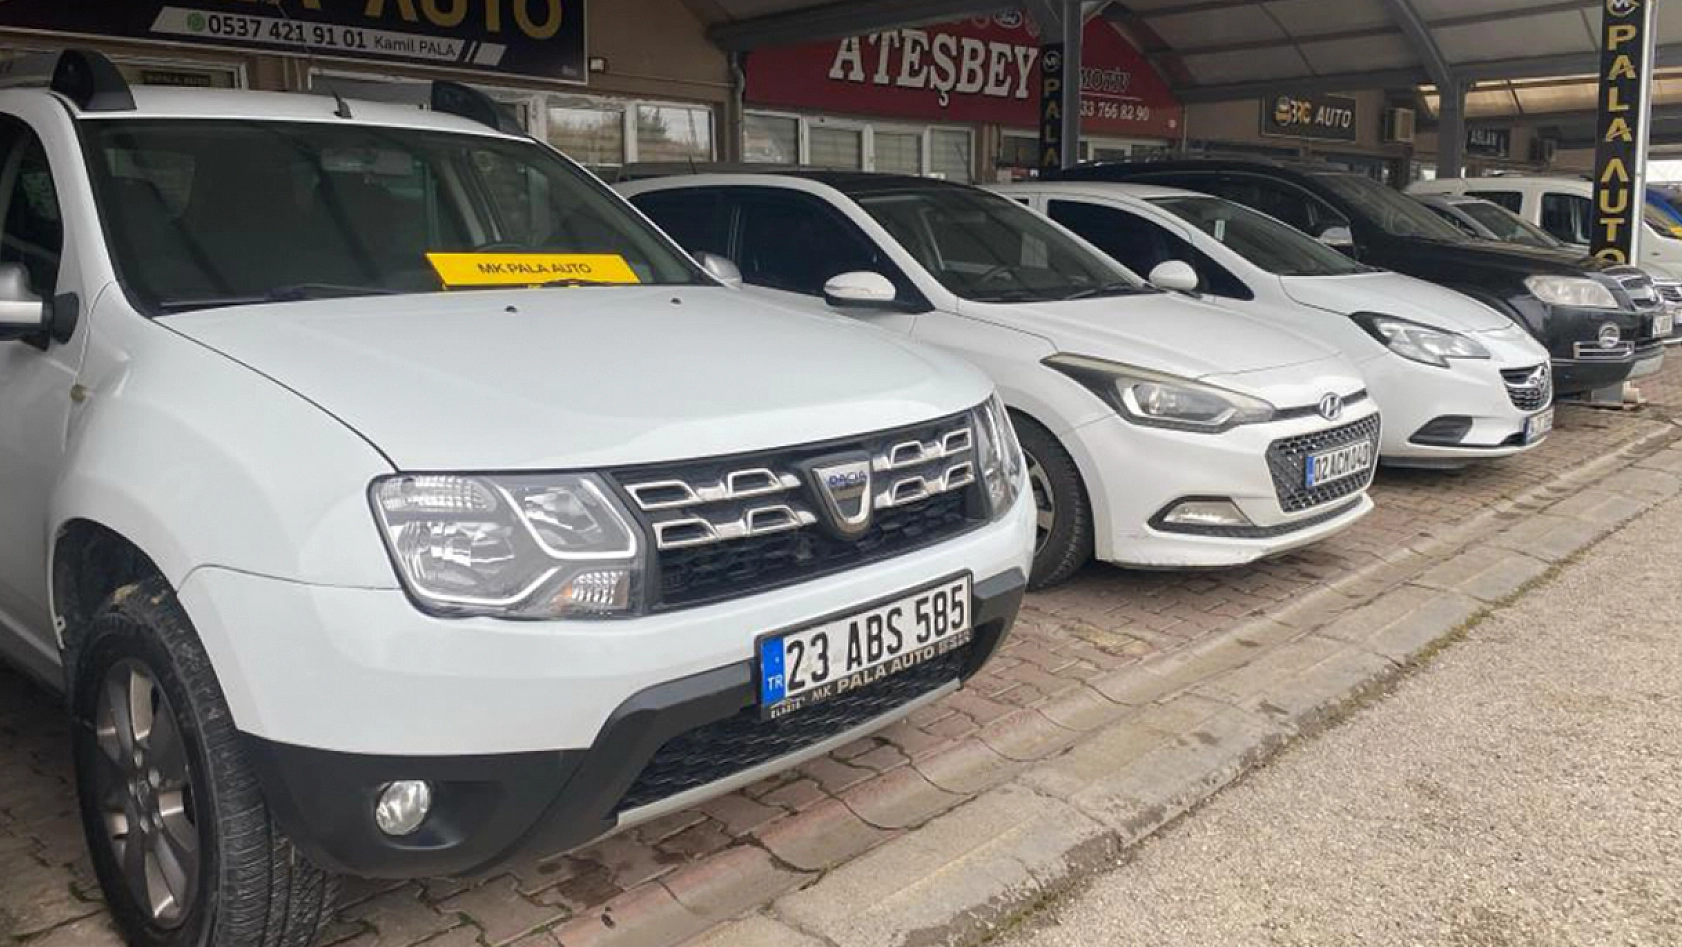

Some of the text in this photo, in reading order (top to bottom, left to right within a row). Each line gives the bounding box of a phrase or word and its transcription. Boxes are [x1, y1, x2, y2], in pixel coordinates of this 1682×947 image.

[208, 14, 457, 56] 0537 421 91 01 Kamil PALA
[828, 28, 1040, 107] ATEŞBEY
[1606, 25, 1636, 142] PALA
[1043, 78, 1061, 168] PALA
[1097, 101, 1118, 120] 766
[1119, 103, 1135, 120] 82
[1136, 105, 1150, 121] 90
[1316, 105, 1352, 128] AUTO
[1596, 158, 1630, 266] AUTO
[509, 263, 550, 274] PALA
[552, 263, 592, 274] AUTO
[786, 631, 830, 691] 23
[846, 606, 903, 672] ABS
[915, 583, 965, 644] 585
[767, 674, 784, 691] TR
[811, 685, 832, 701] MK
[837, 664, 886, 694] PALA
[890, 645, 936, 673] AUTO
